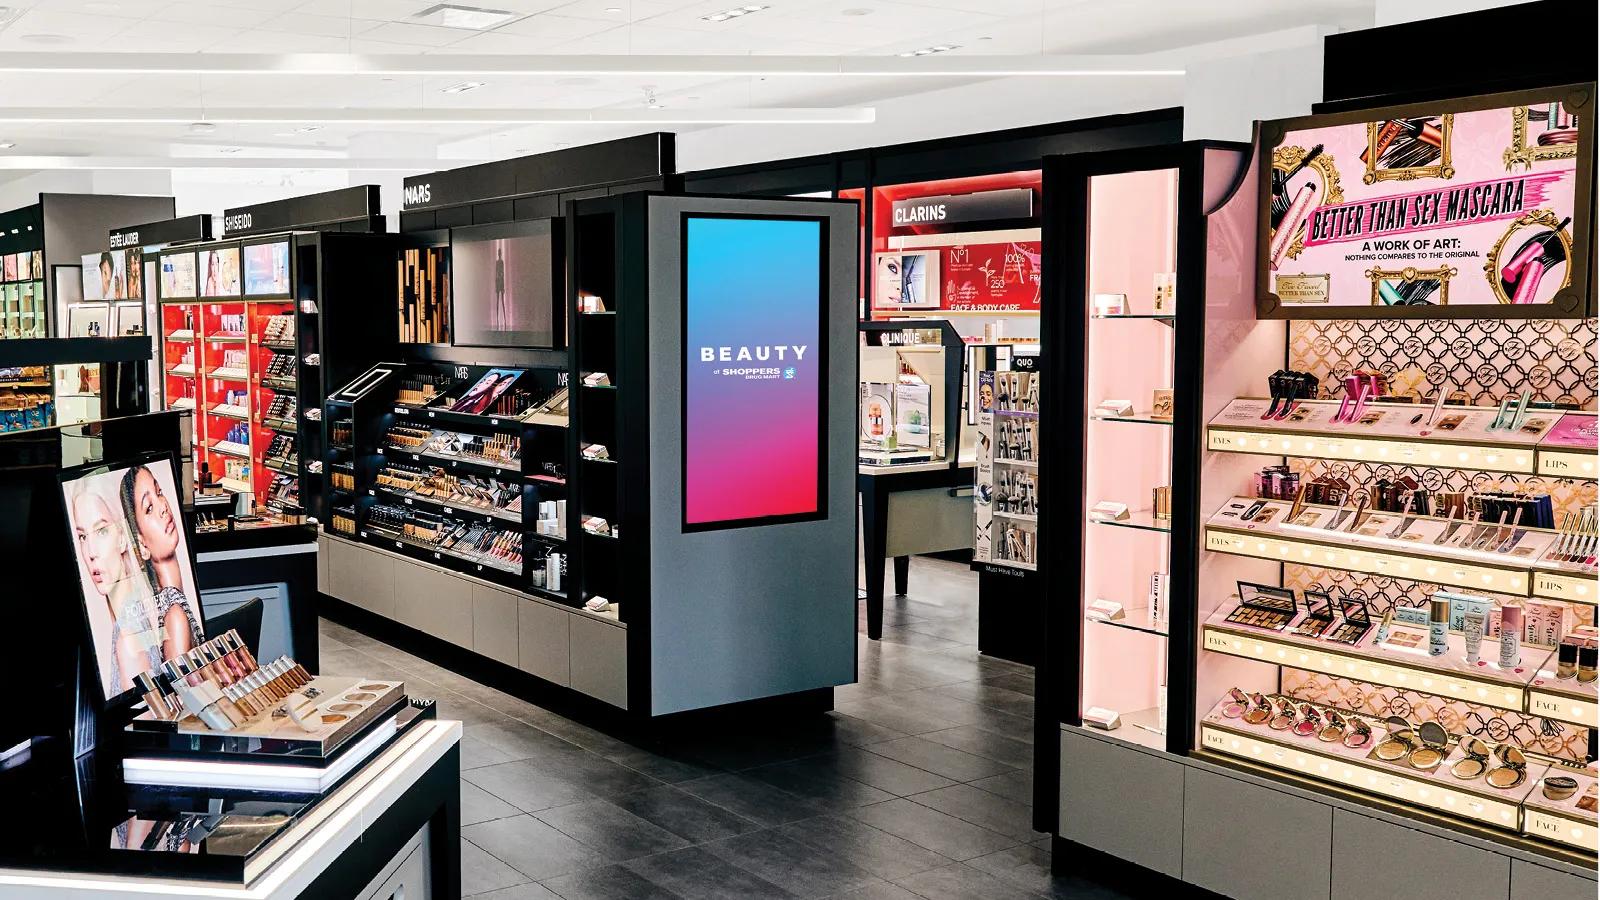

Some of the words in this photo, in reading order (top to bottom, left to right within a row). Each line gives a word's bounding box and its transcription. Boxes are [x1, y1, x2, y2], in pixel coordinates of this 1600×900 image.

[405, 183, 431, 205] NARS
[895, 204, 946, 223] CLARINS
[1312, 205, 1364, 241] BETTER
[1369, 198, 1408, 233] THAN
[1411, 192, 1443, 226] SEX
[1445, 179, 1525, 222] MASCARA
[225, 213, 252, 231] SHISEIDO
[123, 232, 139, 246] LAUDER
[1362, 241, 1371, 252] A
[1373, 240, 1410, 251] WORK
[1413, 239, 1431, 250] OF
[1433, 238, 1461, 249] ART:
[1005, 254, 1025, 263] 100%
[1377, 252, 1416, 260] COMPARES
[1429, 251, 1443, 259] THE
[1444, 250, 1480, 258] ORIGINAL
[977, 303, 999, 311] BODY
[881, 332, 920, 344] CLINIQUE
[700, 345, 808, 362] BEAUTY
[1016, 358, 1033, 367] QUO
[722, 367, 781, 376] SHOPPERS
[1545, 459, 1568, 469] LIPS
[1211, 537, 1230, 546] EYES
[1540, 580, 1563, 591] LIPS
[1209, 637, 1228, 647] EYES
[1536, 700, 1560, 713] FACE
[1536, 820, 1560, 833] FACE
